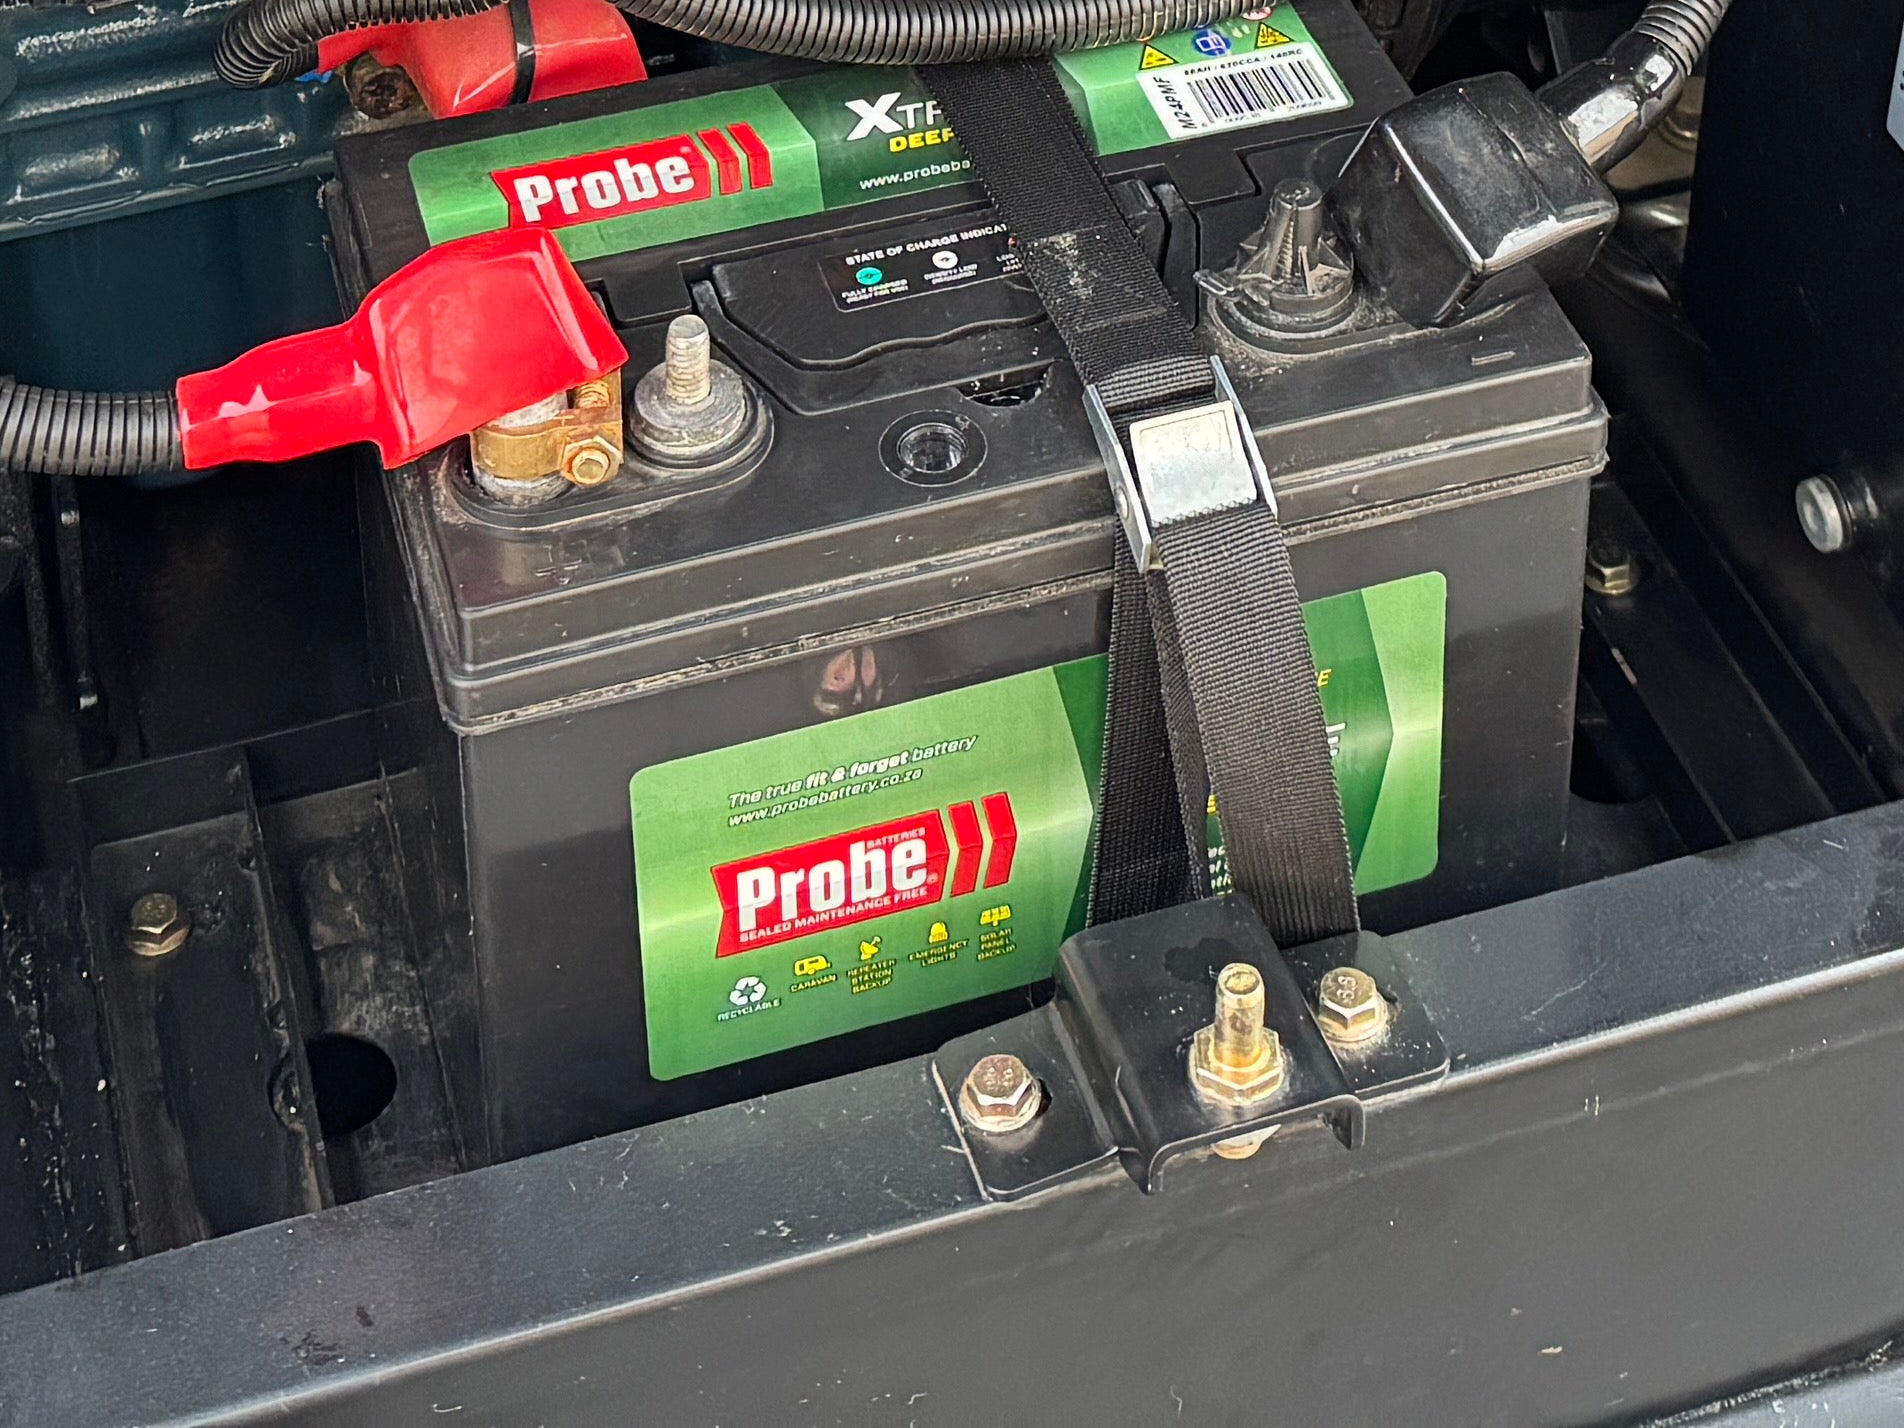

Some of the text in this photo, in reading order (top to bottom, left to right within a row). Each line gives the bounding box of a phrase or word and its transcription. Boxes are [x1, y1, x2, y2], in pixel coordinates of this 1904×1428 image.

[513, 155, 696, 223] Probe
[859, 158, 971, 190] www.probeba
[845, 249, 885, 266] STATE
[886, 244, 904, 257] OF
[906, 233, 960, 253] CHARGE
[728, 734, 979, 810] The true fit & forget battery
[727, 767, 924, 828] www.probebattery.co.za
[866, 826, 927, 849] BATTERIES
[735, 837, 928, 934] Probe
[739, 886, 928, 944] SEALED MAINTENANCE FREE
[790, 973, 838, 993] CARAVAN
[716, 997, 783, 1023] RECYCLABLE
